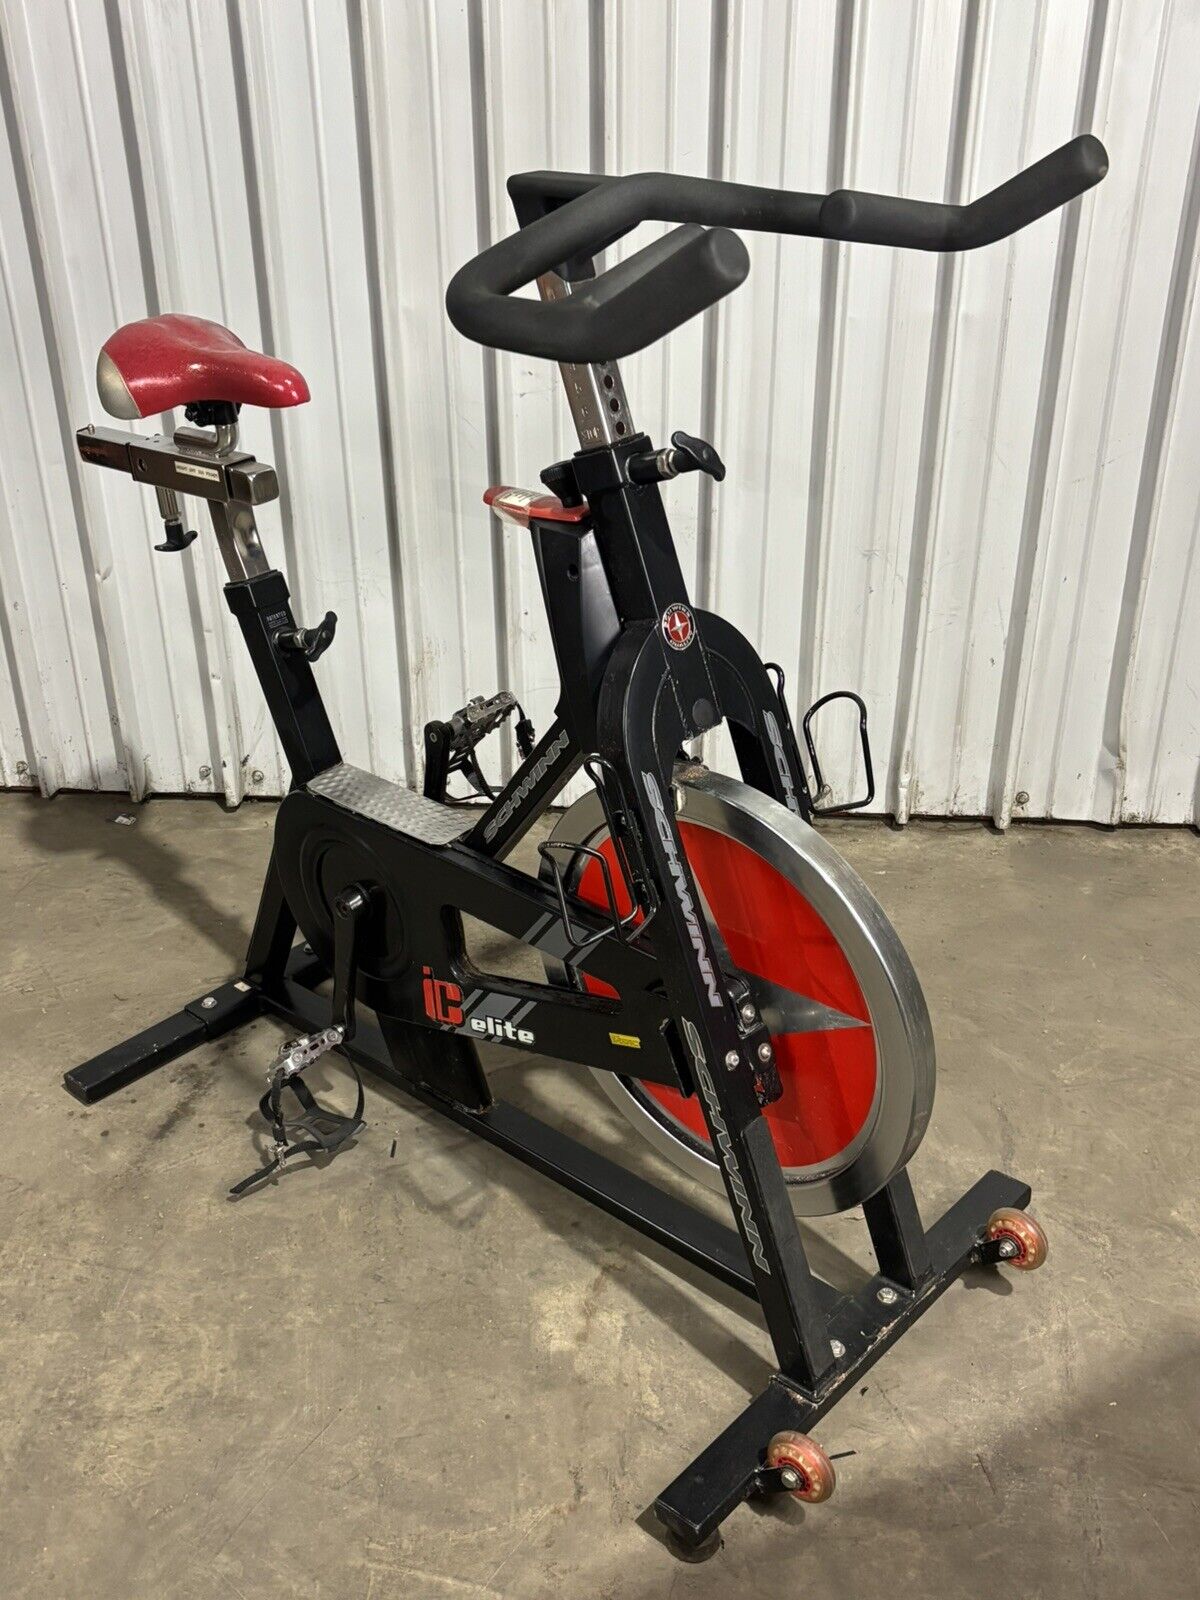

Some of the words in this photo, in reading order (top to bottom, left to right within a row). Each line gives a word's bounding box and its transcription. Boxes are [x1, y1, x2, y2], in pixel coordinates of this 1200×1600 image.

[483, 729, 570, 844] SCHWINN
[641, 770, 724, 1007] SCHWINN
[470, 1016, 535, 1045] elite
[681, 1016, 771, 1275] SCHWINN
